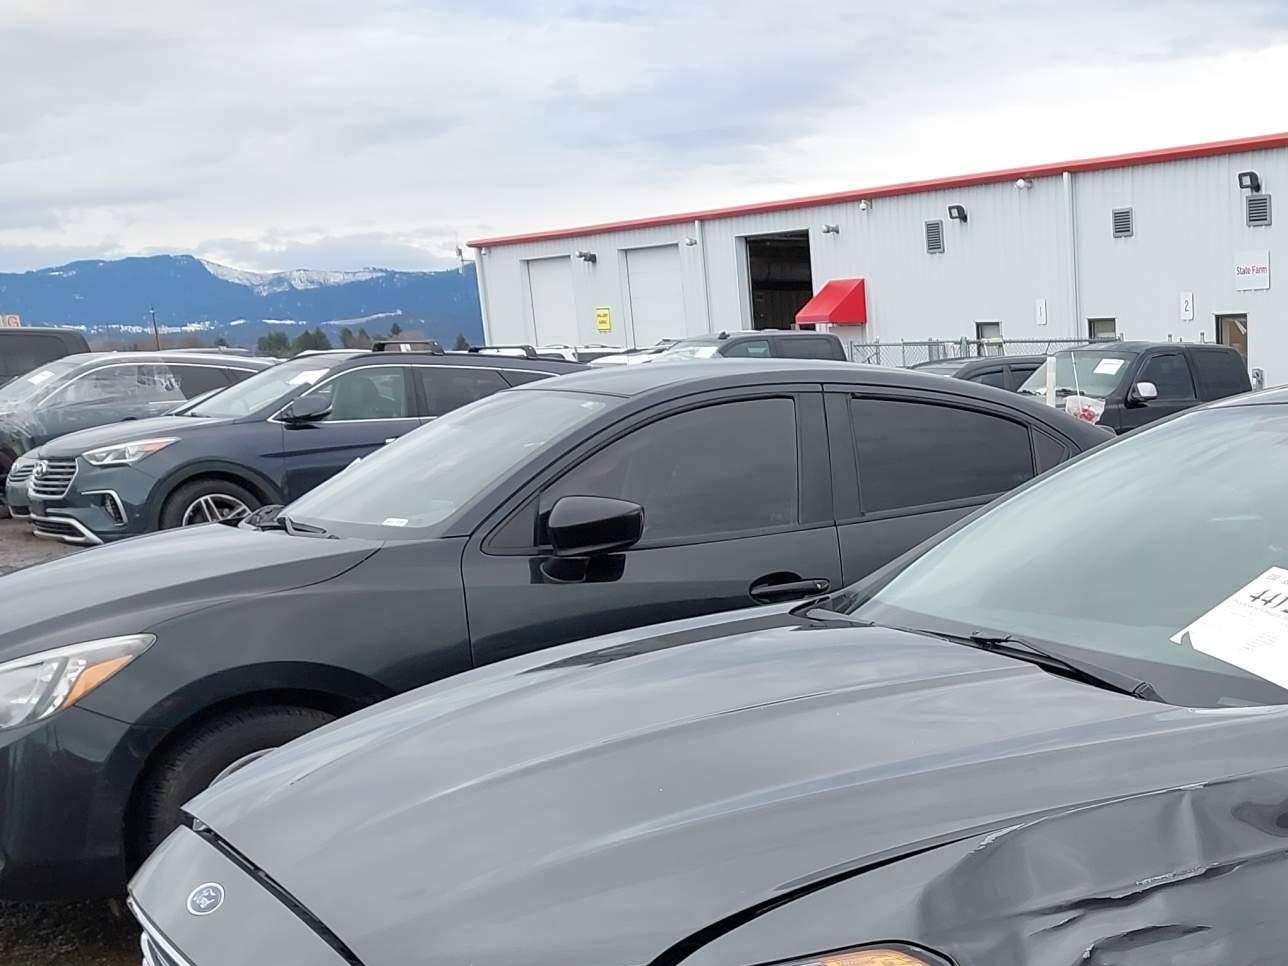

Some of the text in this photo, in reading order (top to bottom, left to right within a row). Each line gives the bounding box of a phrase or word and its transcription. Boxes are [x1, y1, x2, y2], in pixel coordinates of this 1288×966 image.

[1236, 265, 1268, 275] State Farm
[1184, 299, 1190, 312] 2
